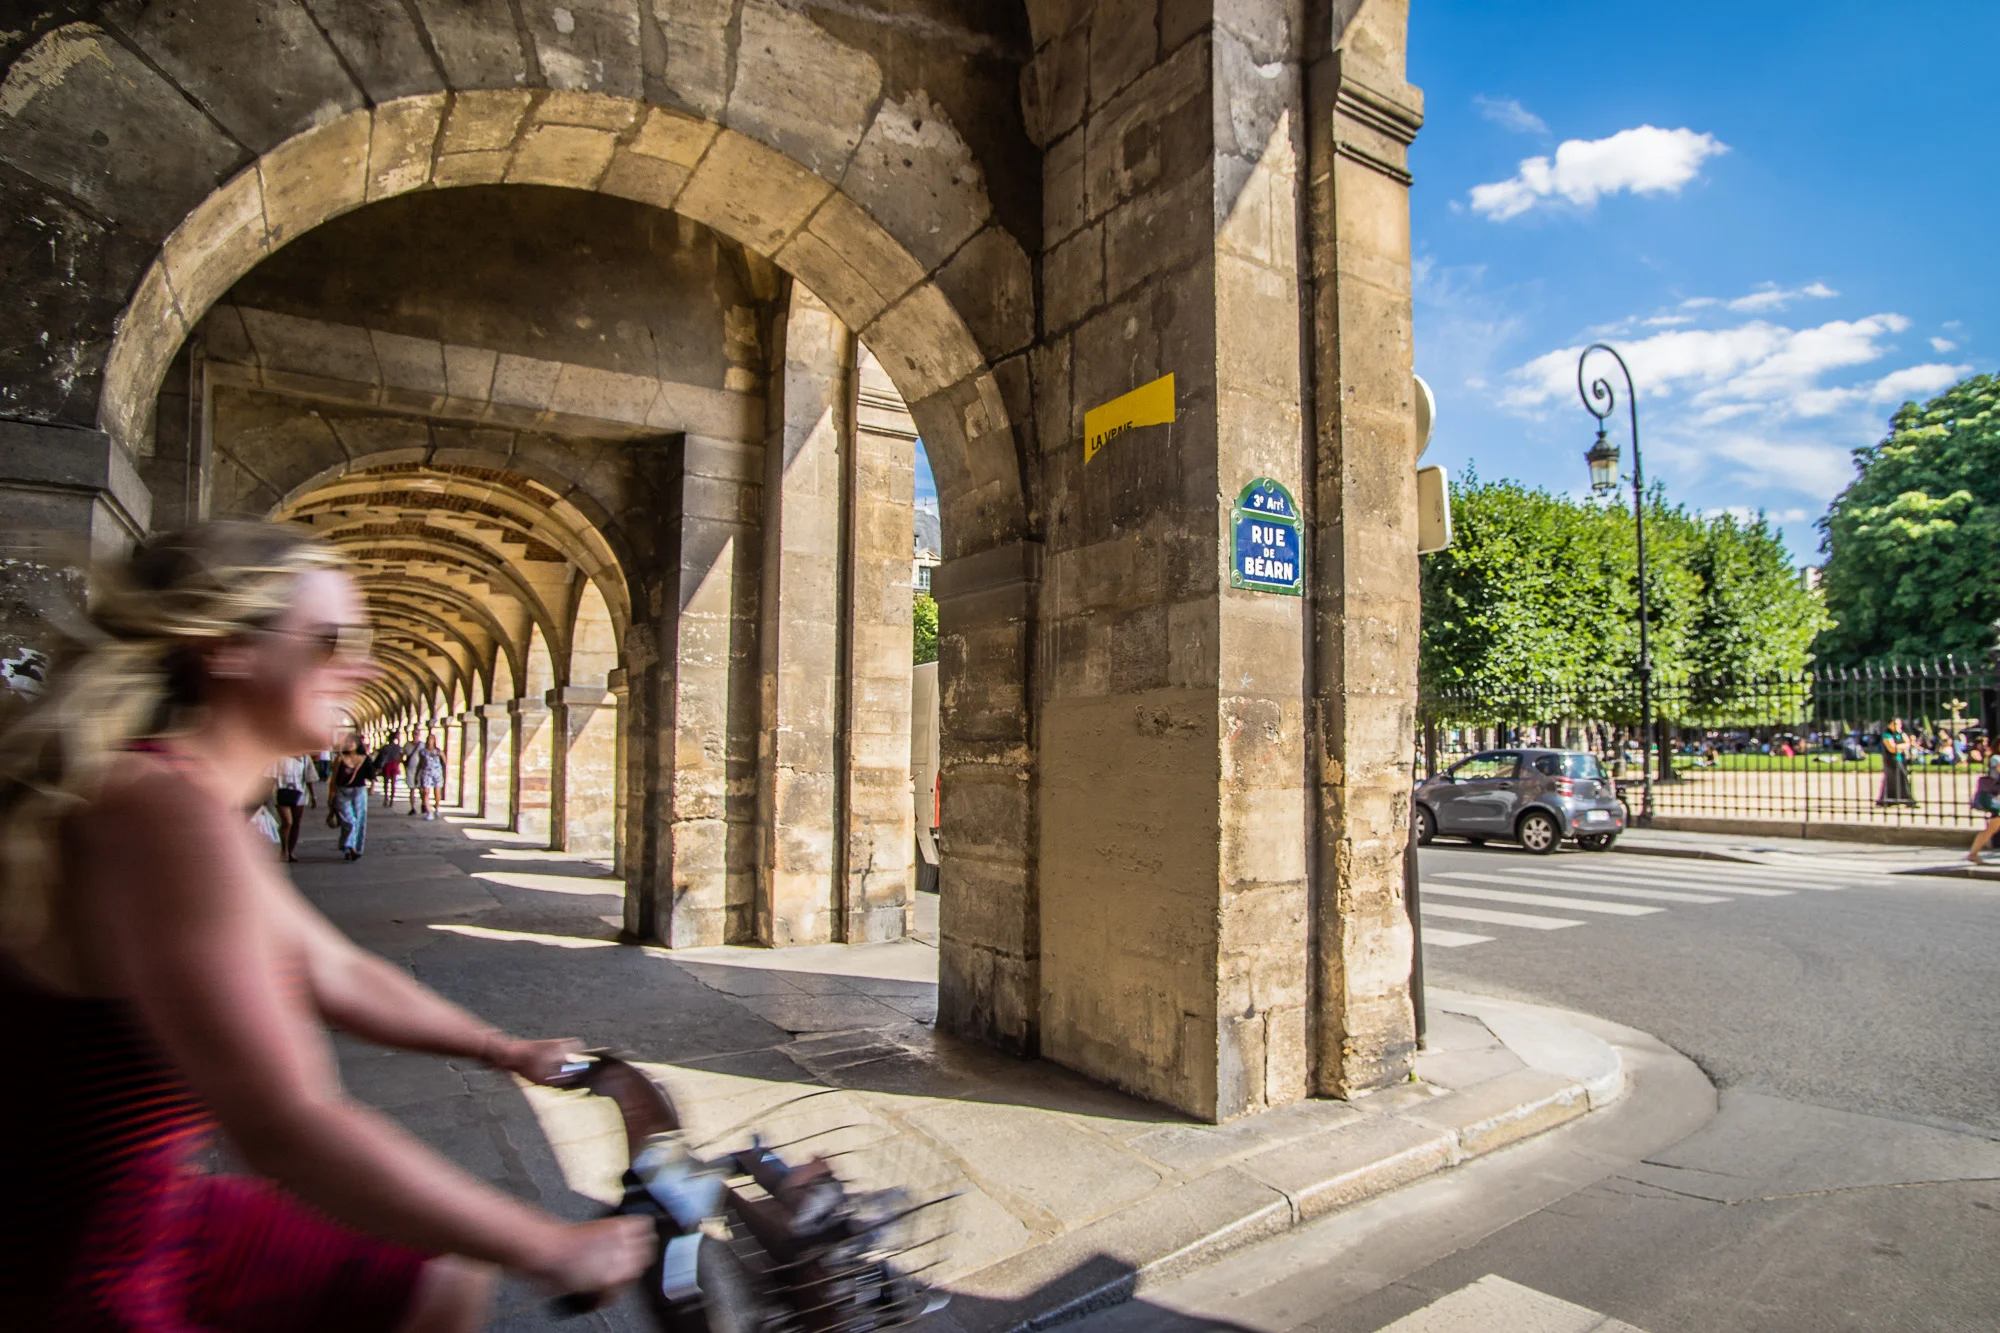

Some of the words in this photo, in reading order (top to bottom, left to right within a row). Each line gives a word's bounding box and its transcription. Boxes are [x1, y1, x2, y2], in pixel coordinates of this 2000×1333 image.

[1091, 435, 1102, 450] LA
[1252, 525, 1285, 547] RUE
[1263, 548, 1275, 558] DE
[1244, 556, 1293, 580] BÉARN
